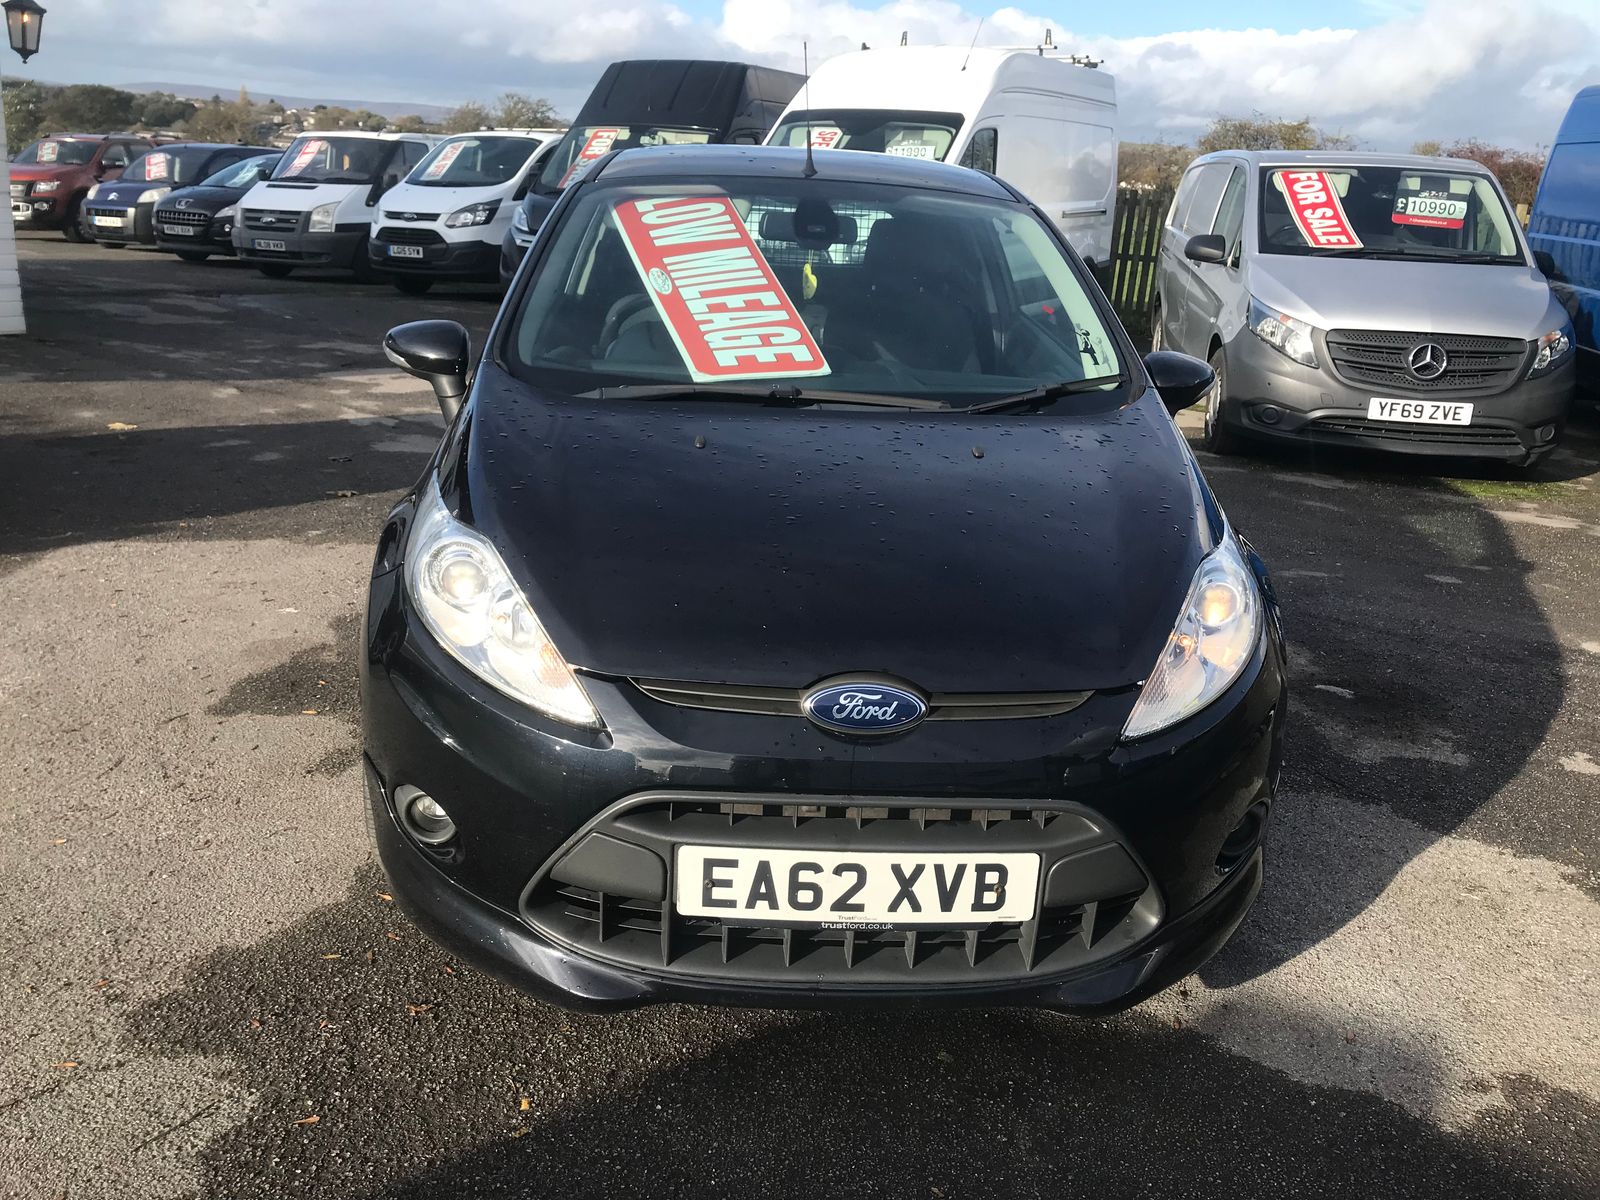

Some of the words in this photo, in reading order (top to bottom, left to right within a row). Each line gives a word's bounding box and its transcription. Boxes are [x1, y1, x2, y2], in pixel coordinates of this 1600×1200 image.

[585, 131, 617, 155] FOR
[1288, 172, 1327, 205] FOR
[634, 197, 743, 247] LOW
[1303, 207, 1349, 244] SALE
[662, 246, 815, 367] MILEAGE
[1378, 401, 1425, 419] YF69
[1428, 405, 1465, 421] ZVE
[832, 692, 899, 720] Ford
[702, 858, 868, 912] EA62
[887, 863, 1009, 913] XVB
[821, 922, 894, 930] trustford.co.uk
